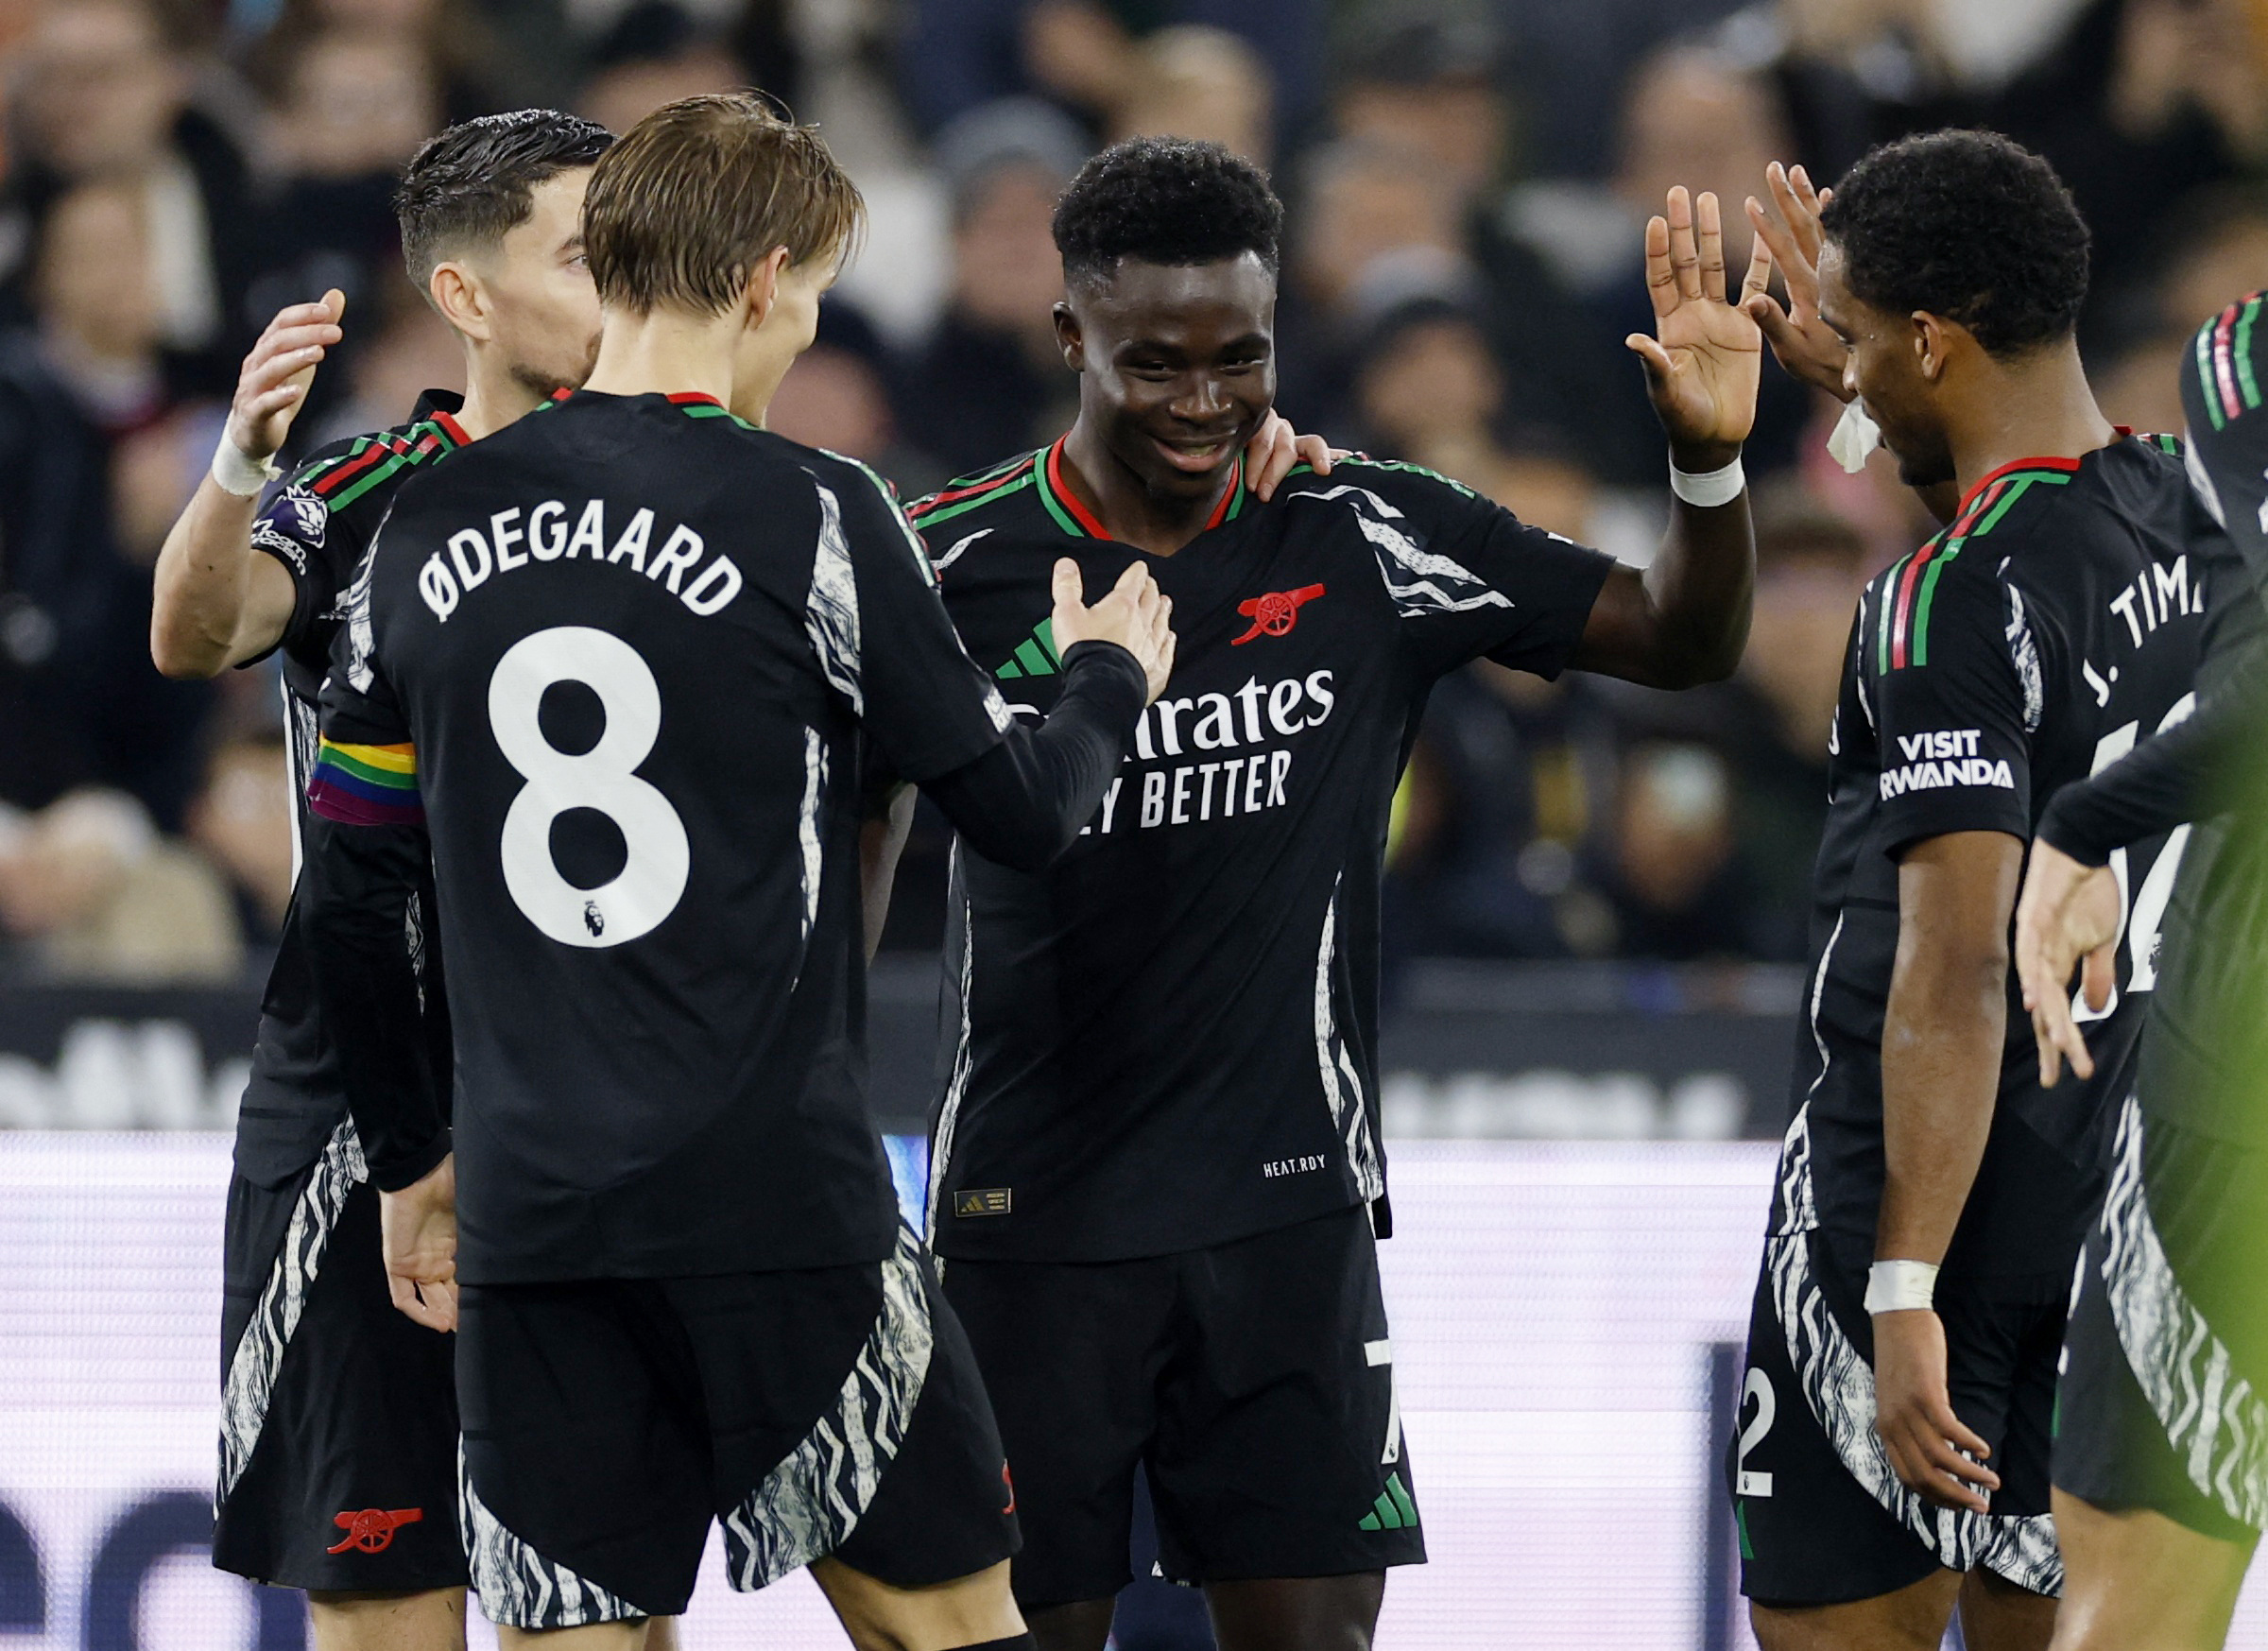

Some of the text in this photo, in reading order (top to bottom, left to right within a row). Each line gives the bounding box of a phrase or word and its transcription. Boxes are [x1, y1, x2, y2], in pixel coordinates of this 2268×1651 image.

[419, 499, 744, 624] ØDEGAARD
[2082, 658, 2120, 709] J.
[1897, 729, 1982, 762] VISIT
[488, 626, 691, 949] 8
[1140, 749, 1292, 829] BETTER
[1879, 758, 2015, 801] RWANDA
[1263, 1154, 1325, 1178] HEAT.RDY
